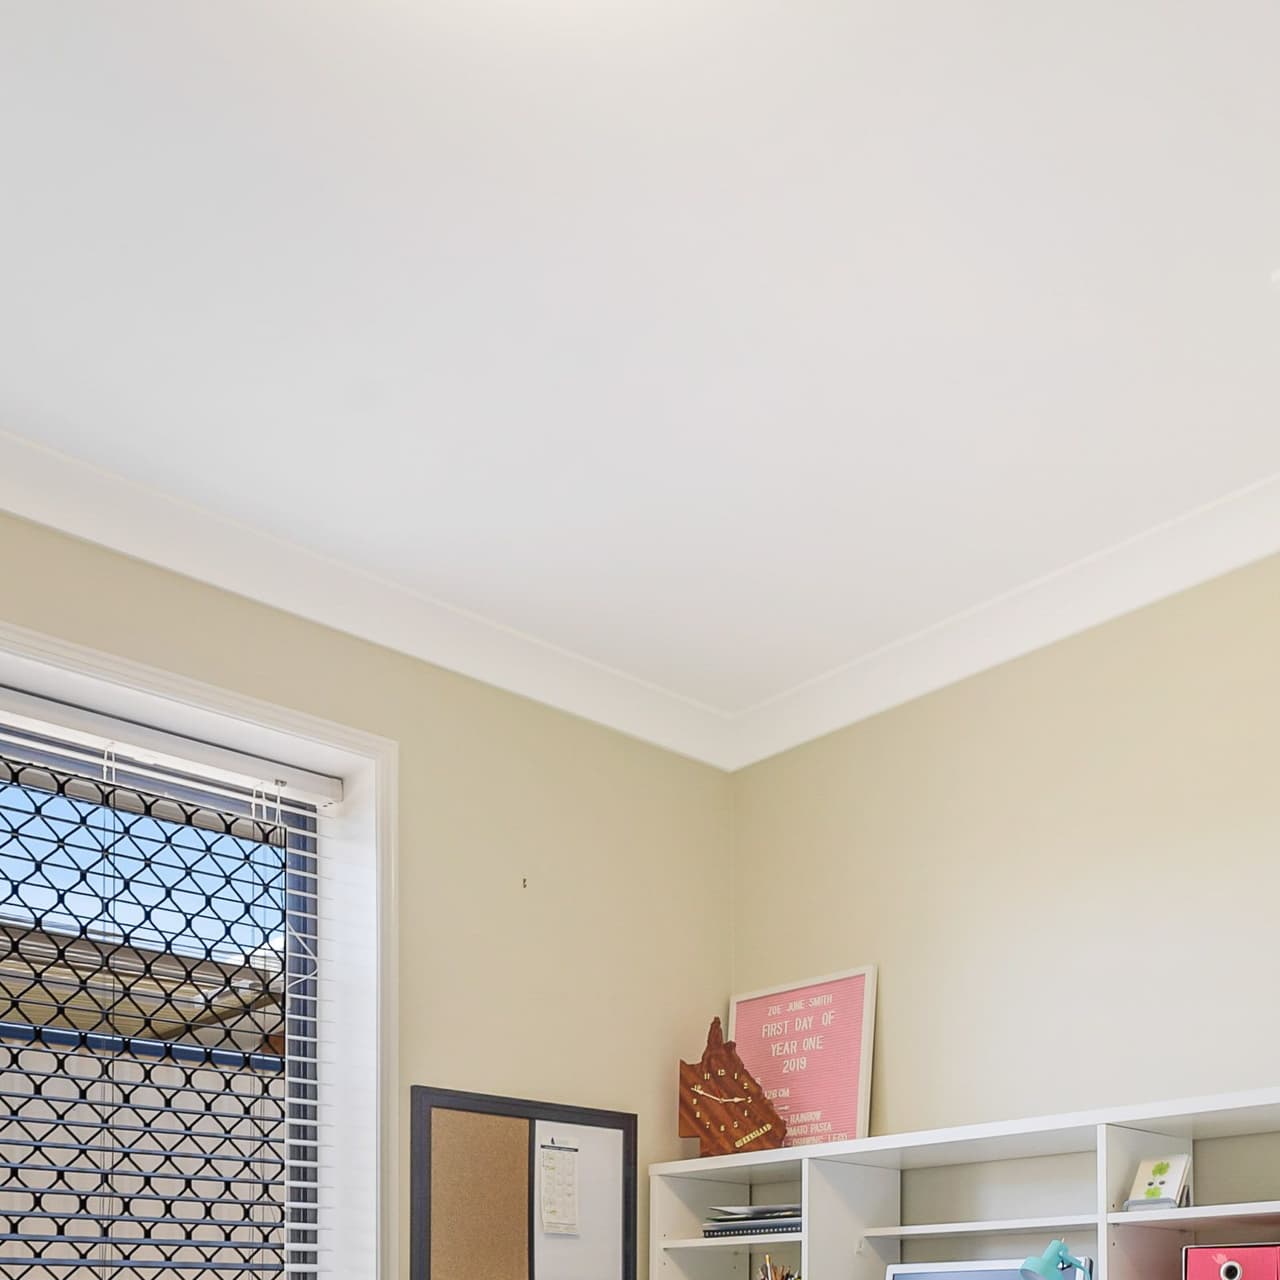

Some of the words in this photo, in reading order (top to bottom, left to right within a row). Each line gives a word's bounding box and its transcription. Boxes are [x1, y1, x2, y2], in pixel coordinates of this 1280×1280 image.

[762, 1020, 791, 1038] FIRST
[795, 1015, 814, 1031] DAY
[821, 1010, 836, 1026] OF
[771, 1040, 798, 1057] YEAR
[802, 1035, 825, 1051] ONE
[782, 1056, 807, 1073] 2019
[790, 1110, 822, 1124] RAINBOW
[734, 1123, 773, 1148] QUEENSLAND
[786, 1124, 808, 1137] OMATO
